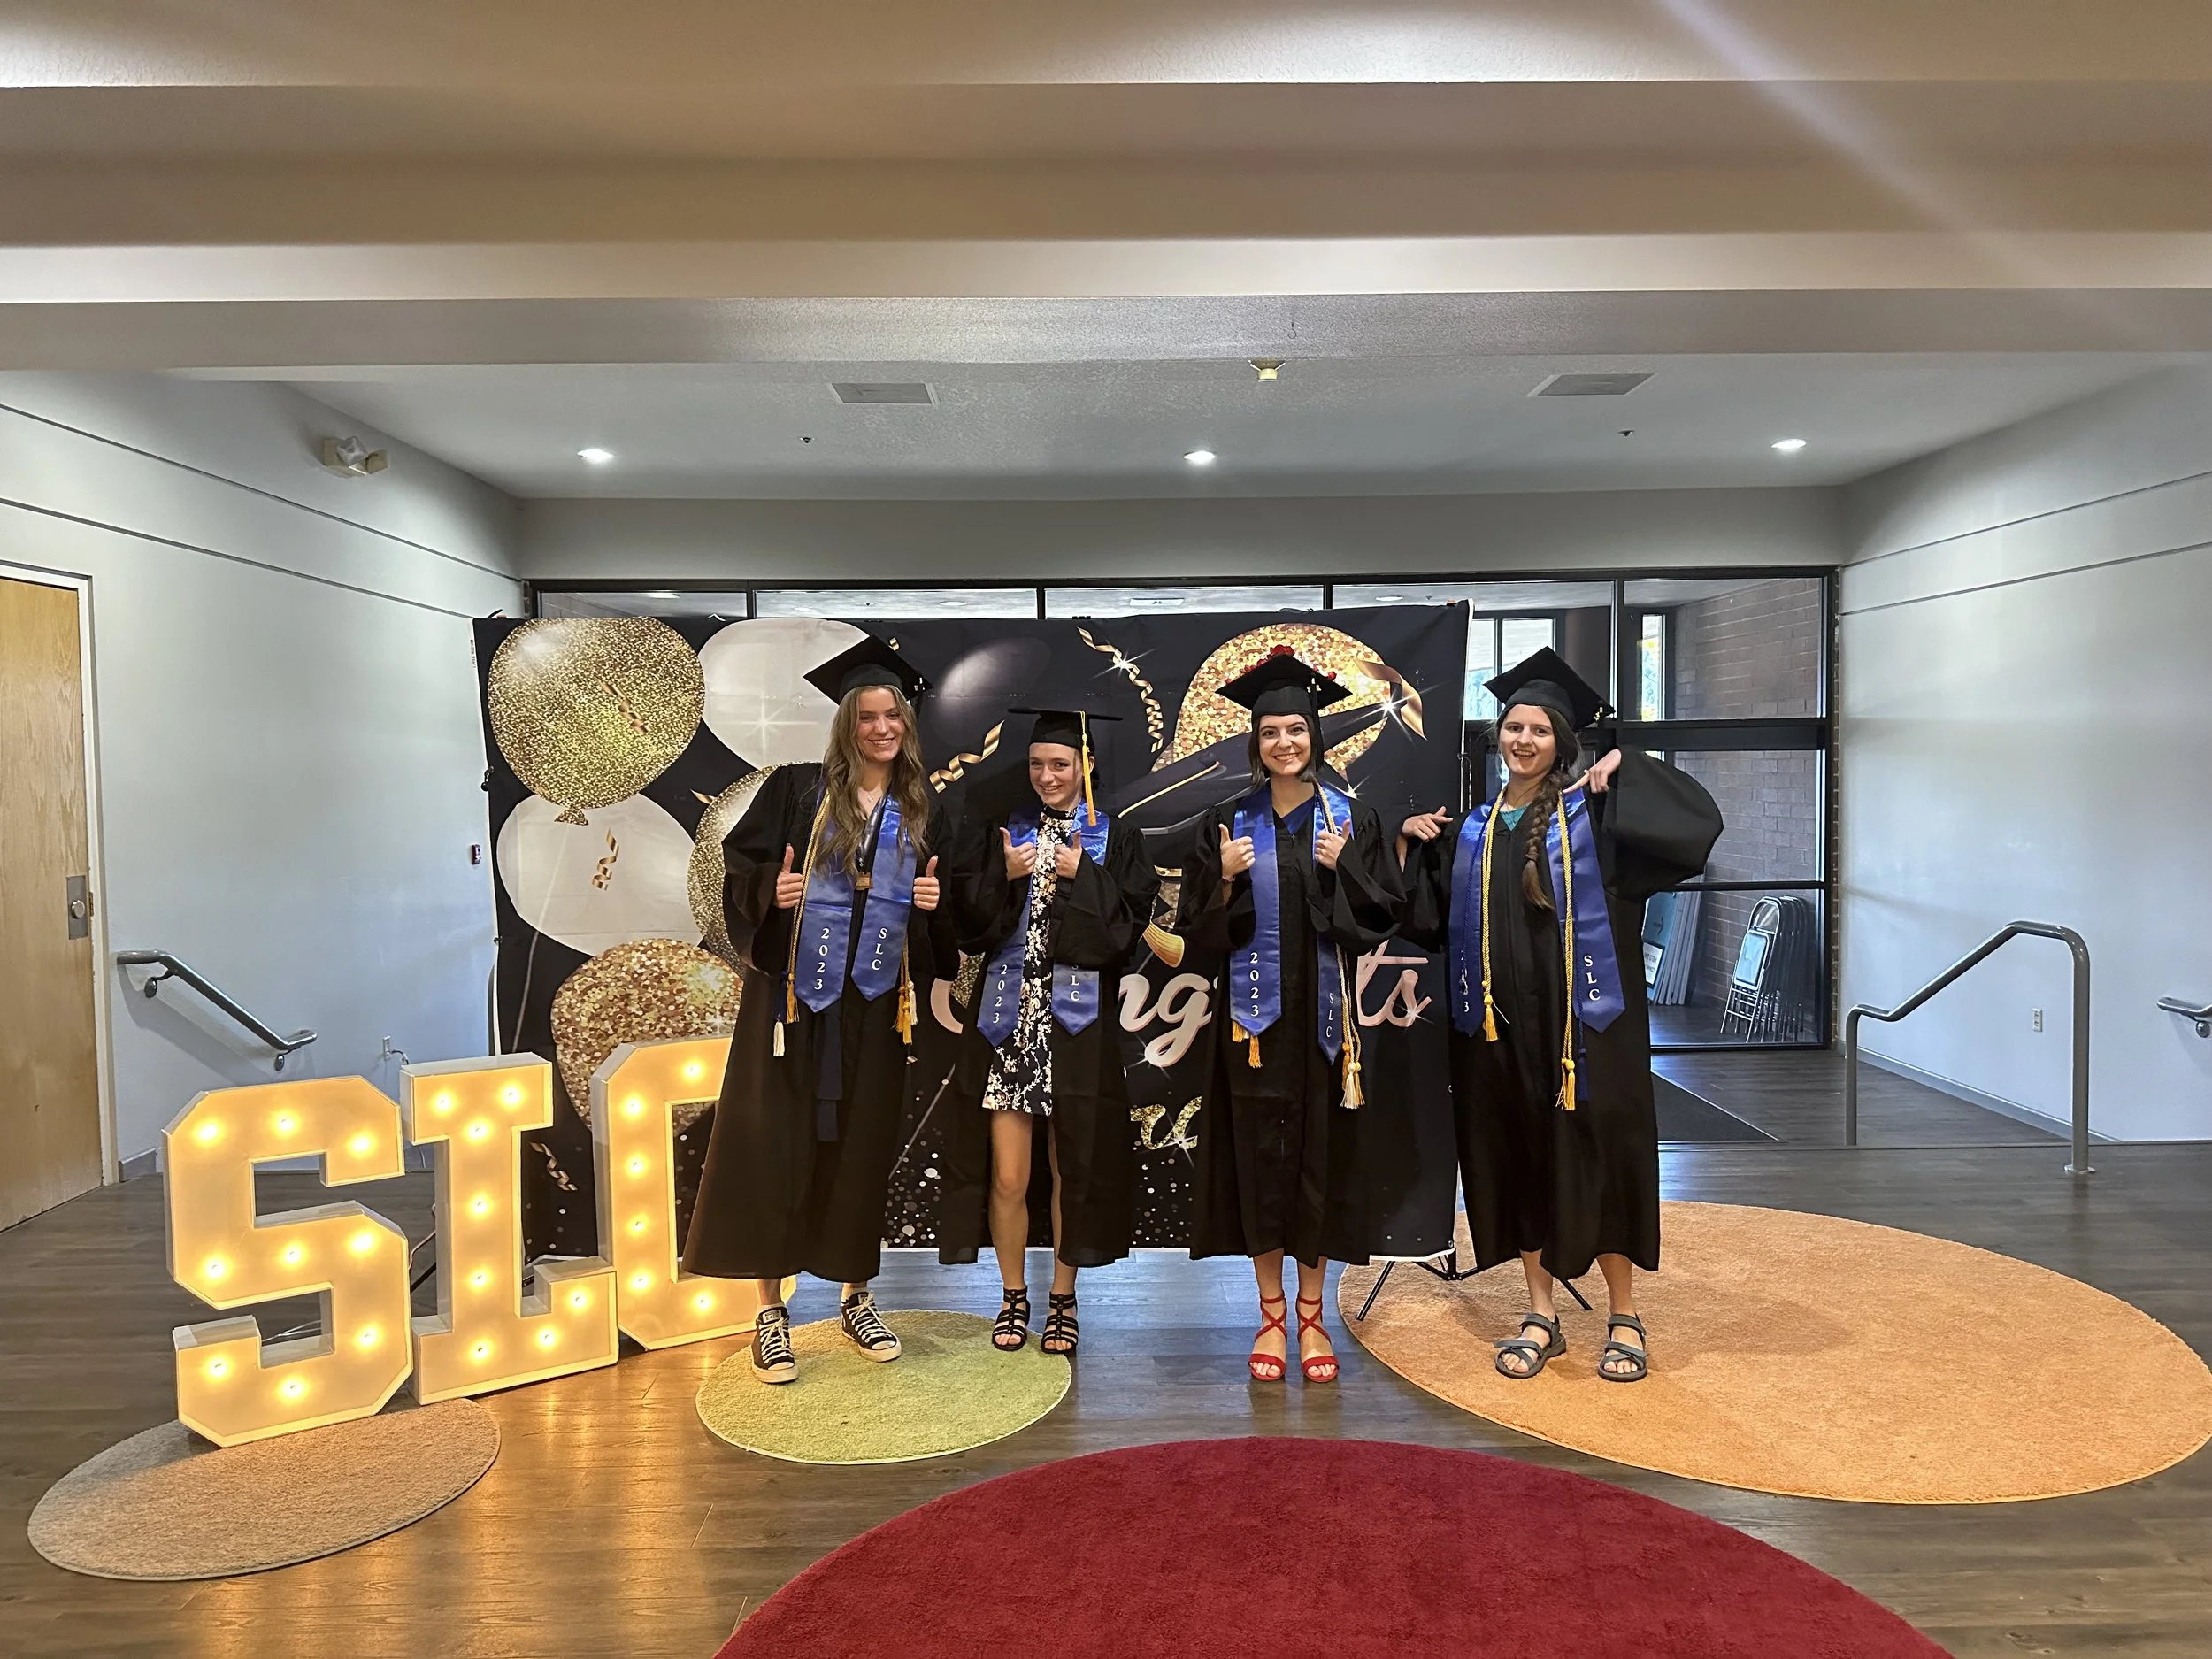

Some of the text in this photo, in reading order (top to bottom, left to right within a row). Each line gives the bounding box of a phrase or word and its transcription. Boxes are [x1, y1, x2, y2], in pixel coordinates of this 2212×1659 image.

[813, 927, 830, 990] 2023
[871, 927, 887, 971] SLC
[1583, 955, 1601, 1002] SLC
[992, 964, 1008, 1024] 2023
[1249, 952, 1259, 1017] 2023
